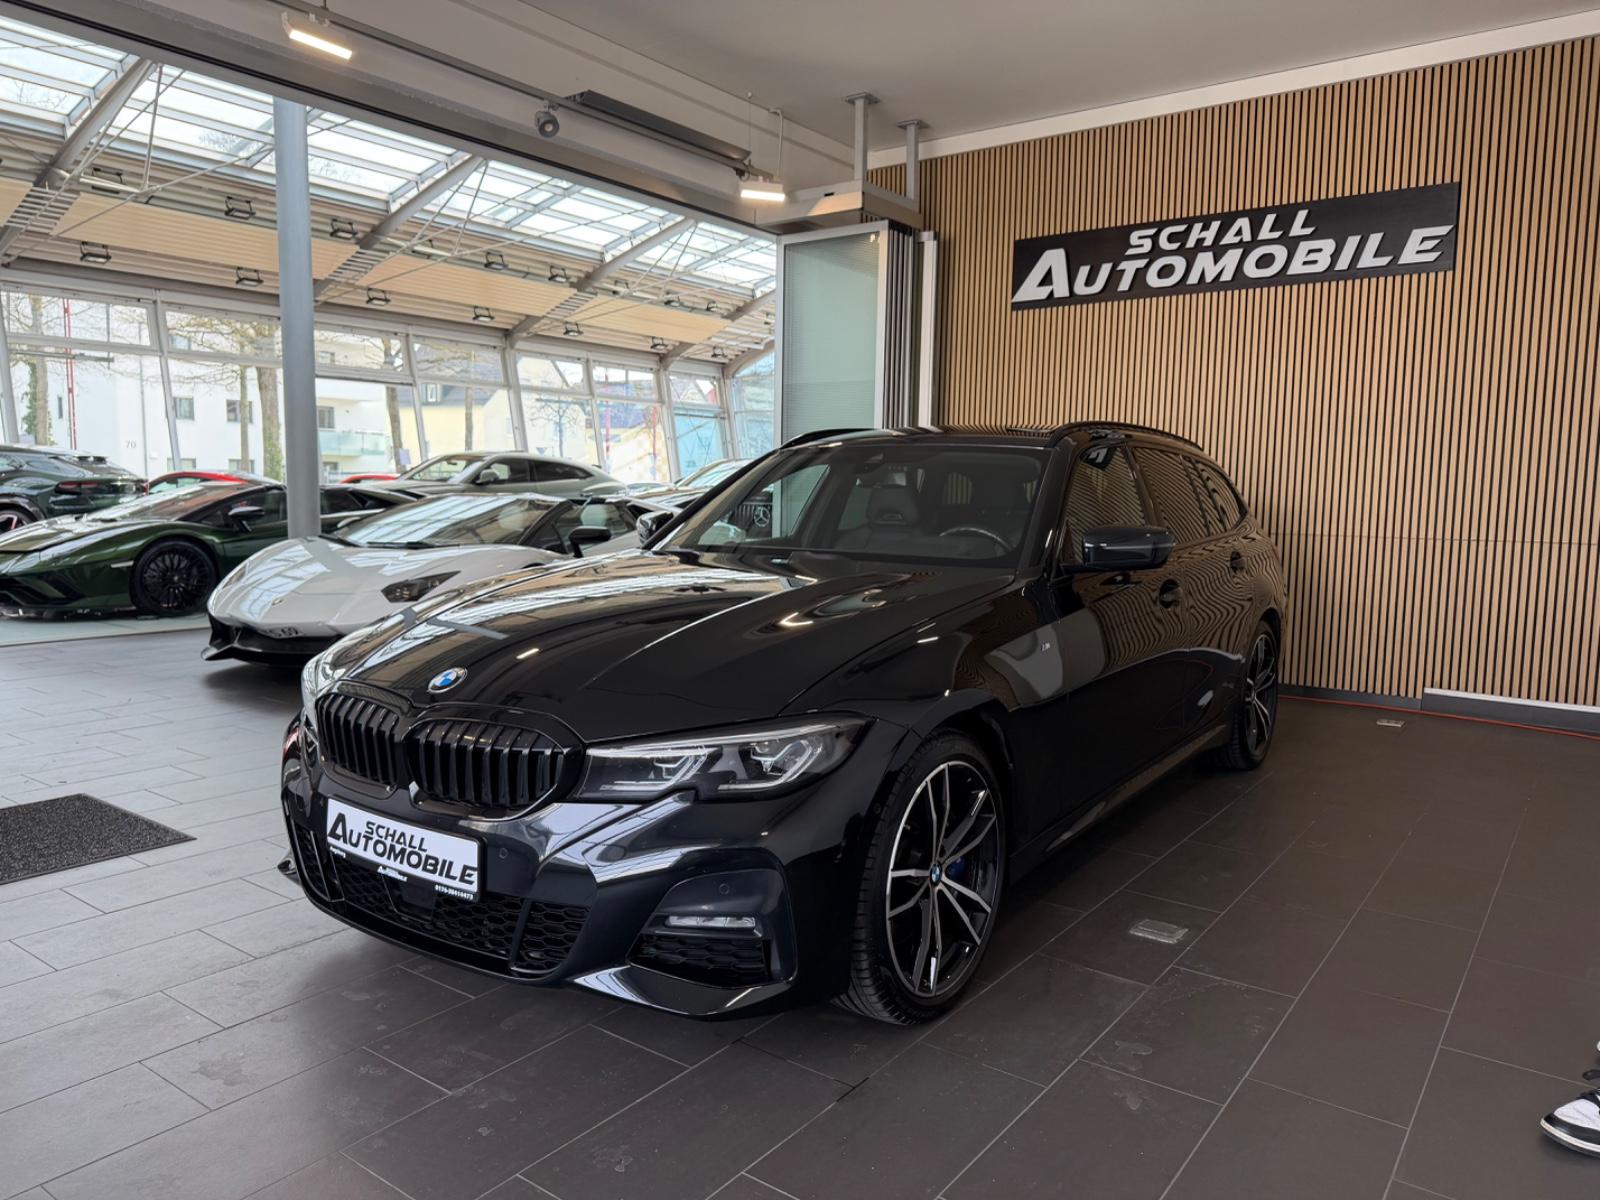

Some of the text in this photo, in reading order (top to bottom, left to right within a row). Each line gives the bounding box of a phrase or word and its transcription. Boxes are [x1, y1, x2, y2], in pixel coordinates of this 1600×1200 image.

[1126, 209, 1318, 255] SCHALL
[1011, 225, 1455, 303] AUTOMOBILE
[125, 439, 136, 449] 70
[327, 812, 478, 886] AUTOMOBILE
[364, 820, 428, 853] SCHALL
